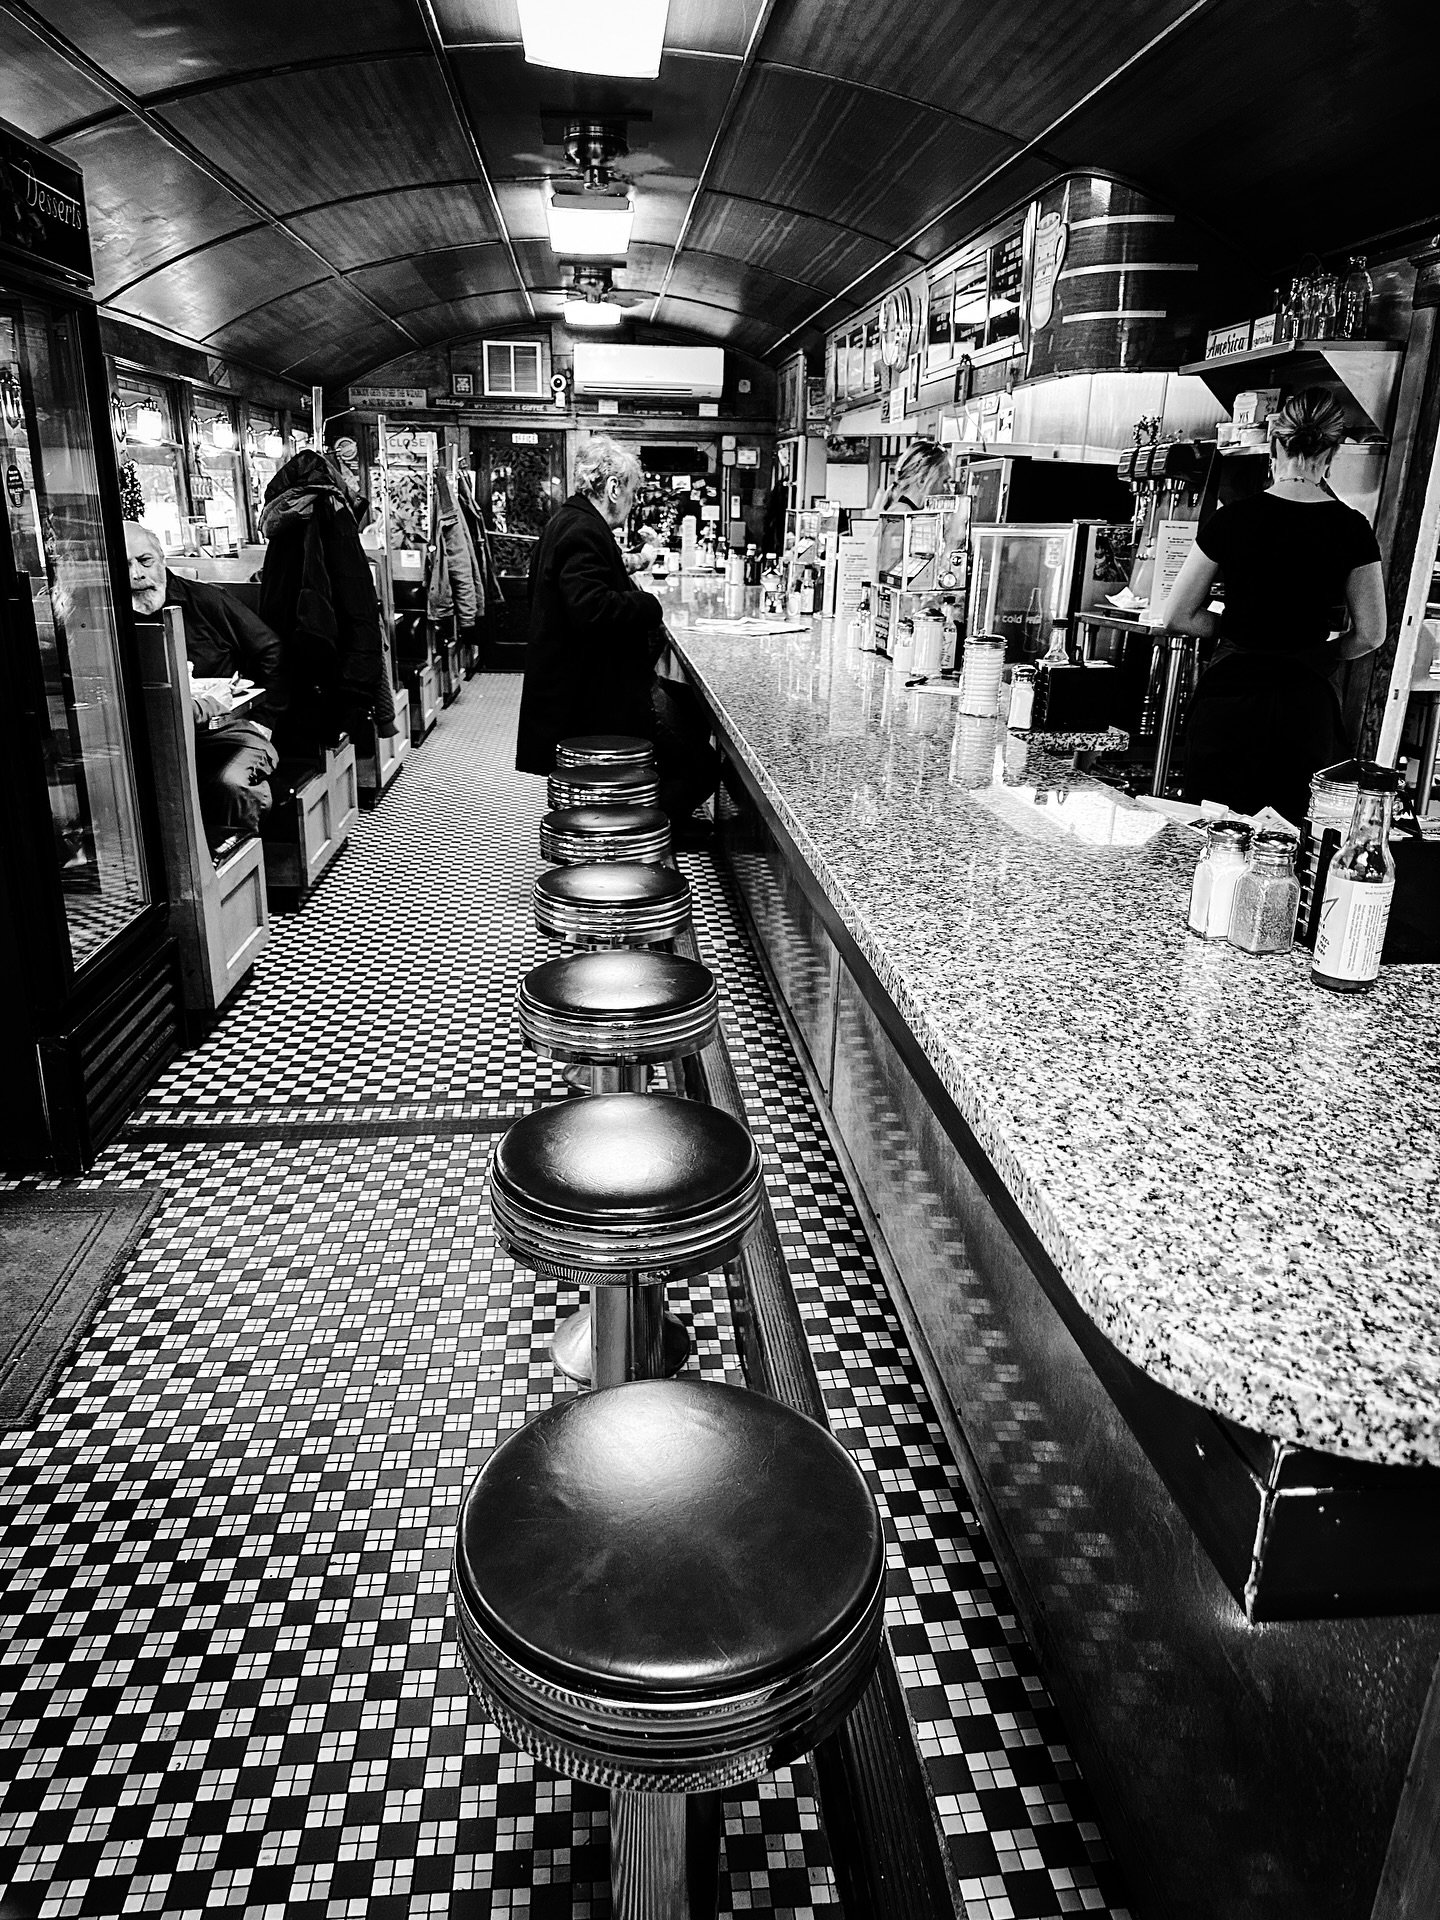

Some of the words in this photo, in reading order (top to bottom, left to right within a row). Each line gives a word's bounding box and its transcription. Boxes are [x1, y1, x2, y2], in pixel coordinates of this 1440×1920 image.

[23, 160, 81, 230] Desserts
[1206, 333, 1248, 358] America
[1002, 614, 1022, 624] cold
